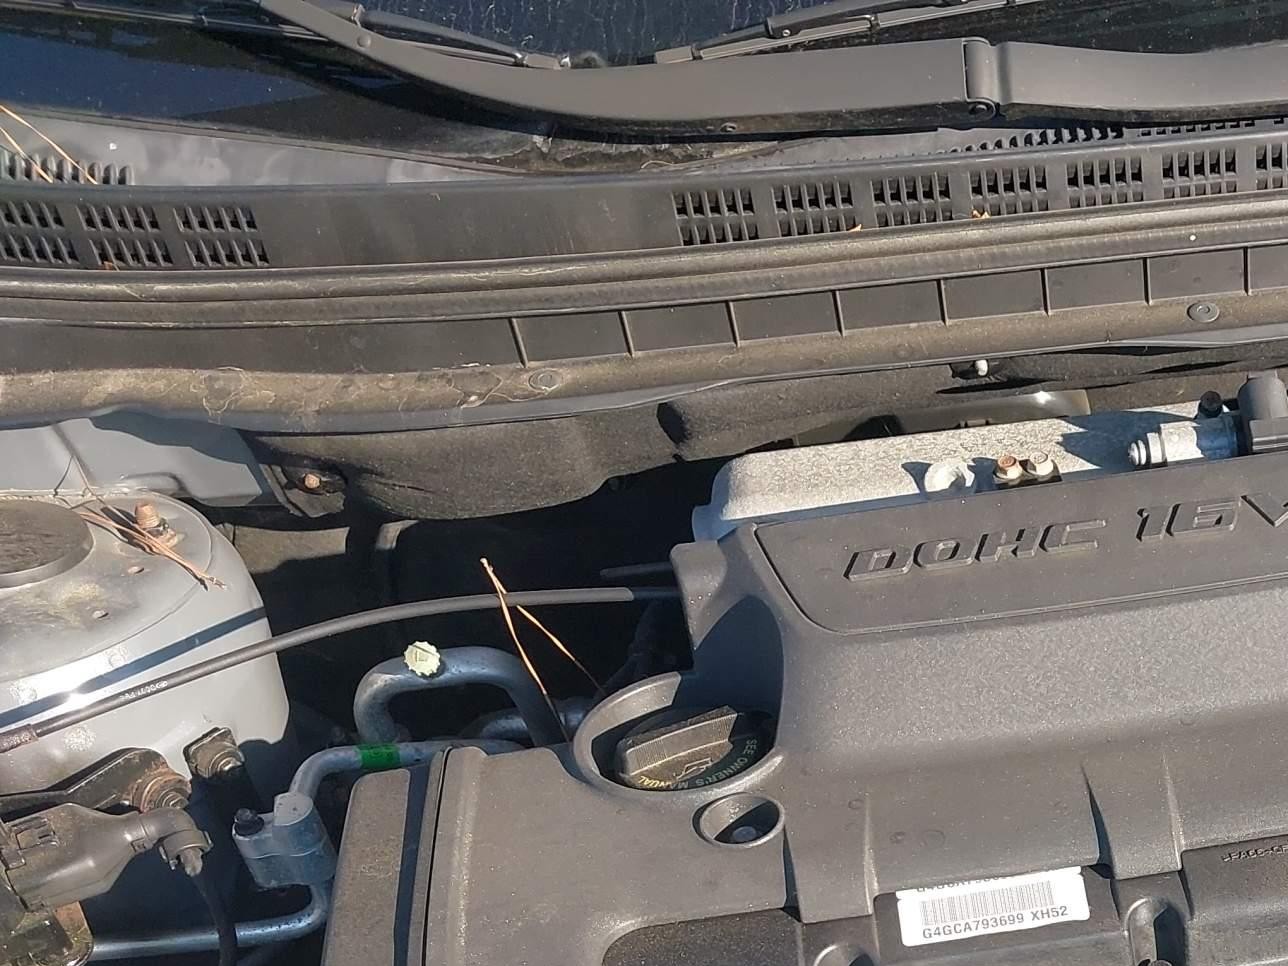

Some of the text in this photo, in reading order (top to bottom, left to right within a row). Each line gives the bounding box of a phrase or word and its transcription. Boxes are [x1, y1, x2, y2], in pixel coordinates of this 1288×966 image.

[843, 520, 1106, 582] DOHC
[695, 757, 749, 787] OWNER'S
[922, 905, 1069, 939] G4GCA793699 XH52
